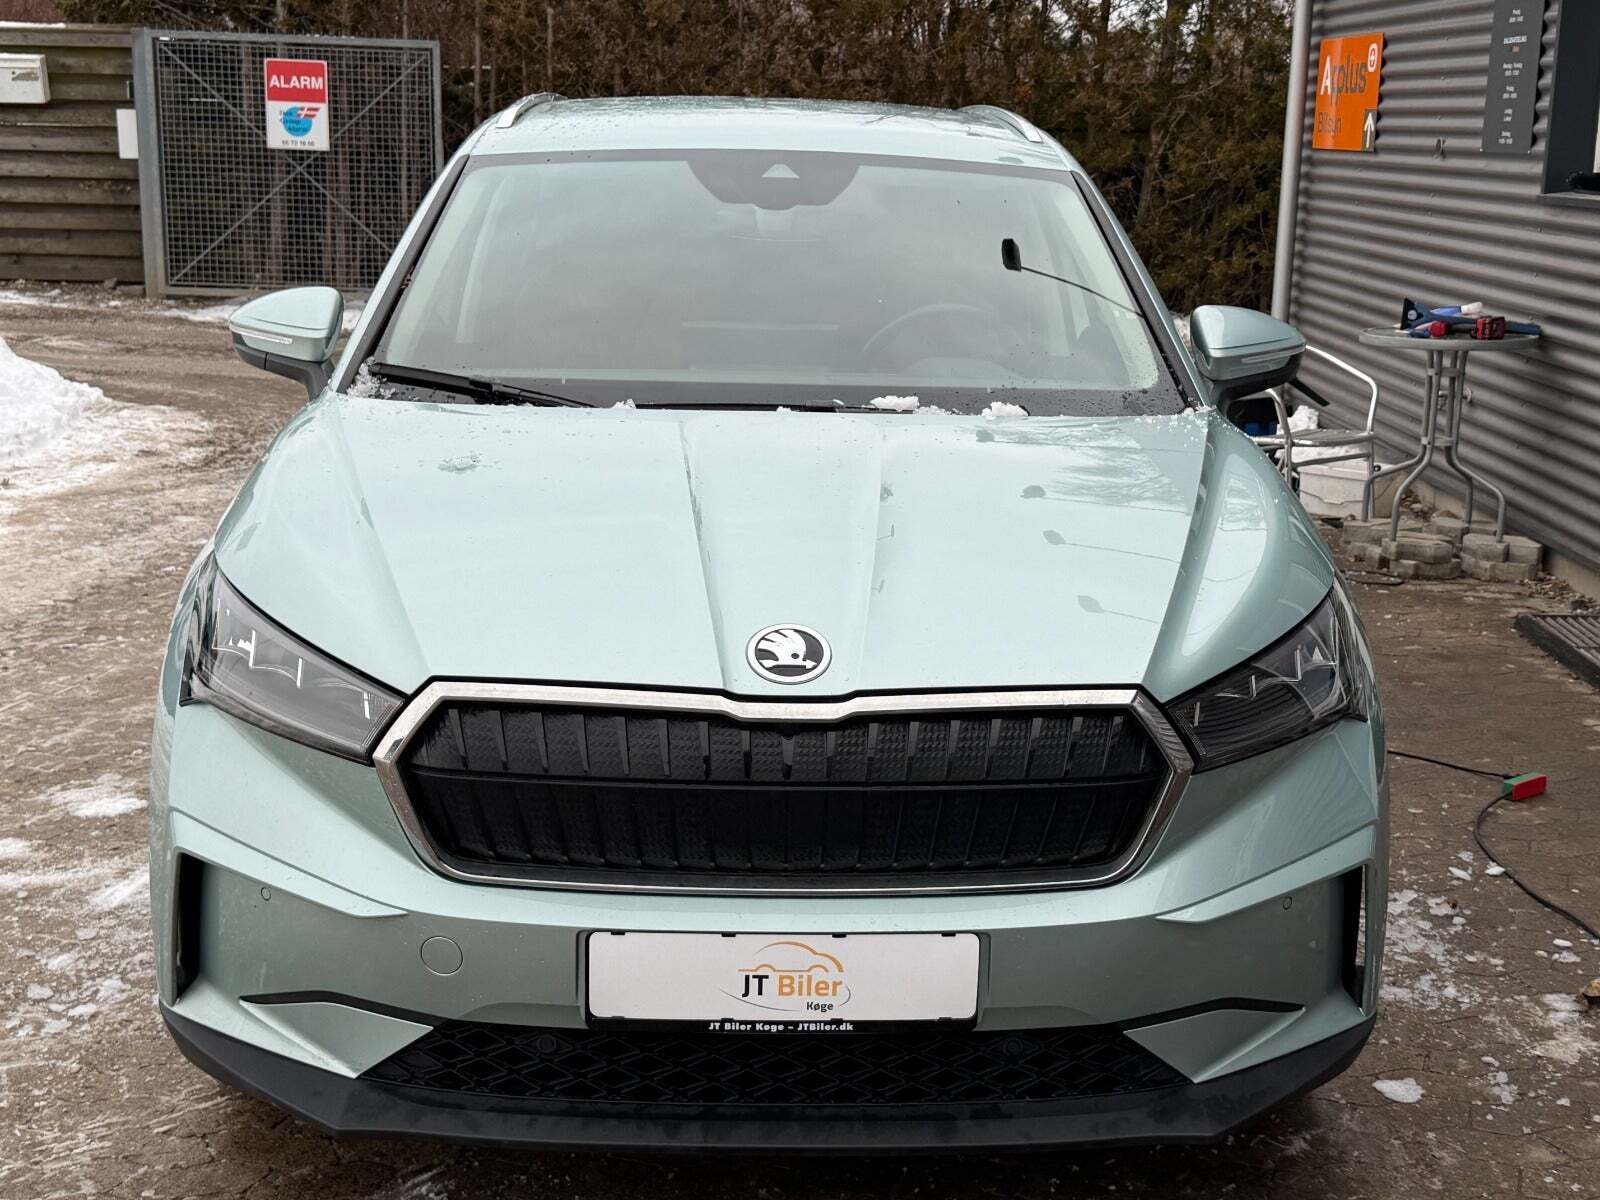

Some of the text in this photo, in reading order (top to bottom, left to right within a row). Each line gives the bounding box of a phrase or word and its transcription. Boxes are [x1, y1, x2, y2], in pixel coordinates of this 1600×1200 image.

[269, 74, 324, 90] ALARM
[741, 974, 843, 998] JT Biler
[806, 1001, 834, 1013] Køge
[708, 1022, 721, 1031] JT
[724, 1022, 752, 1031] Biler
[797, 1022, 854, 1031] JTBiler.dk
